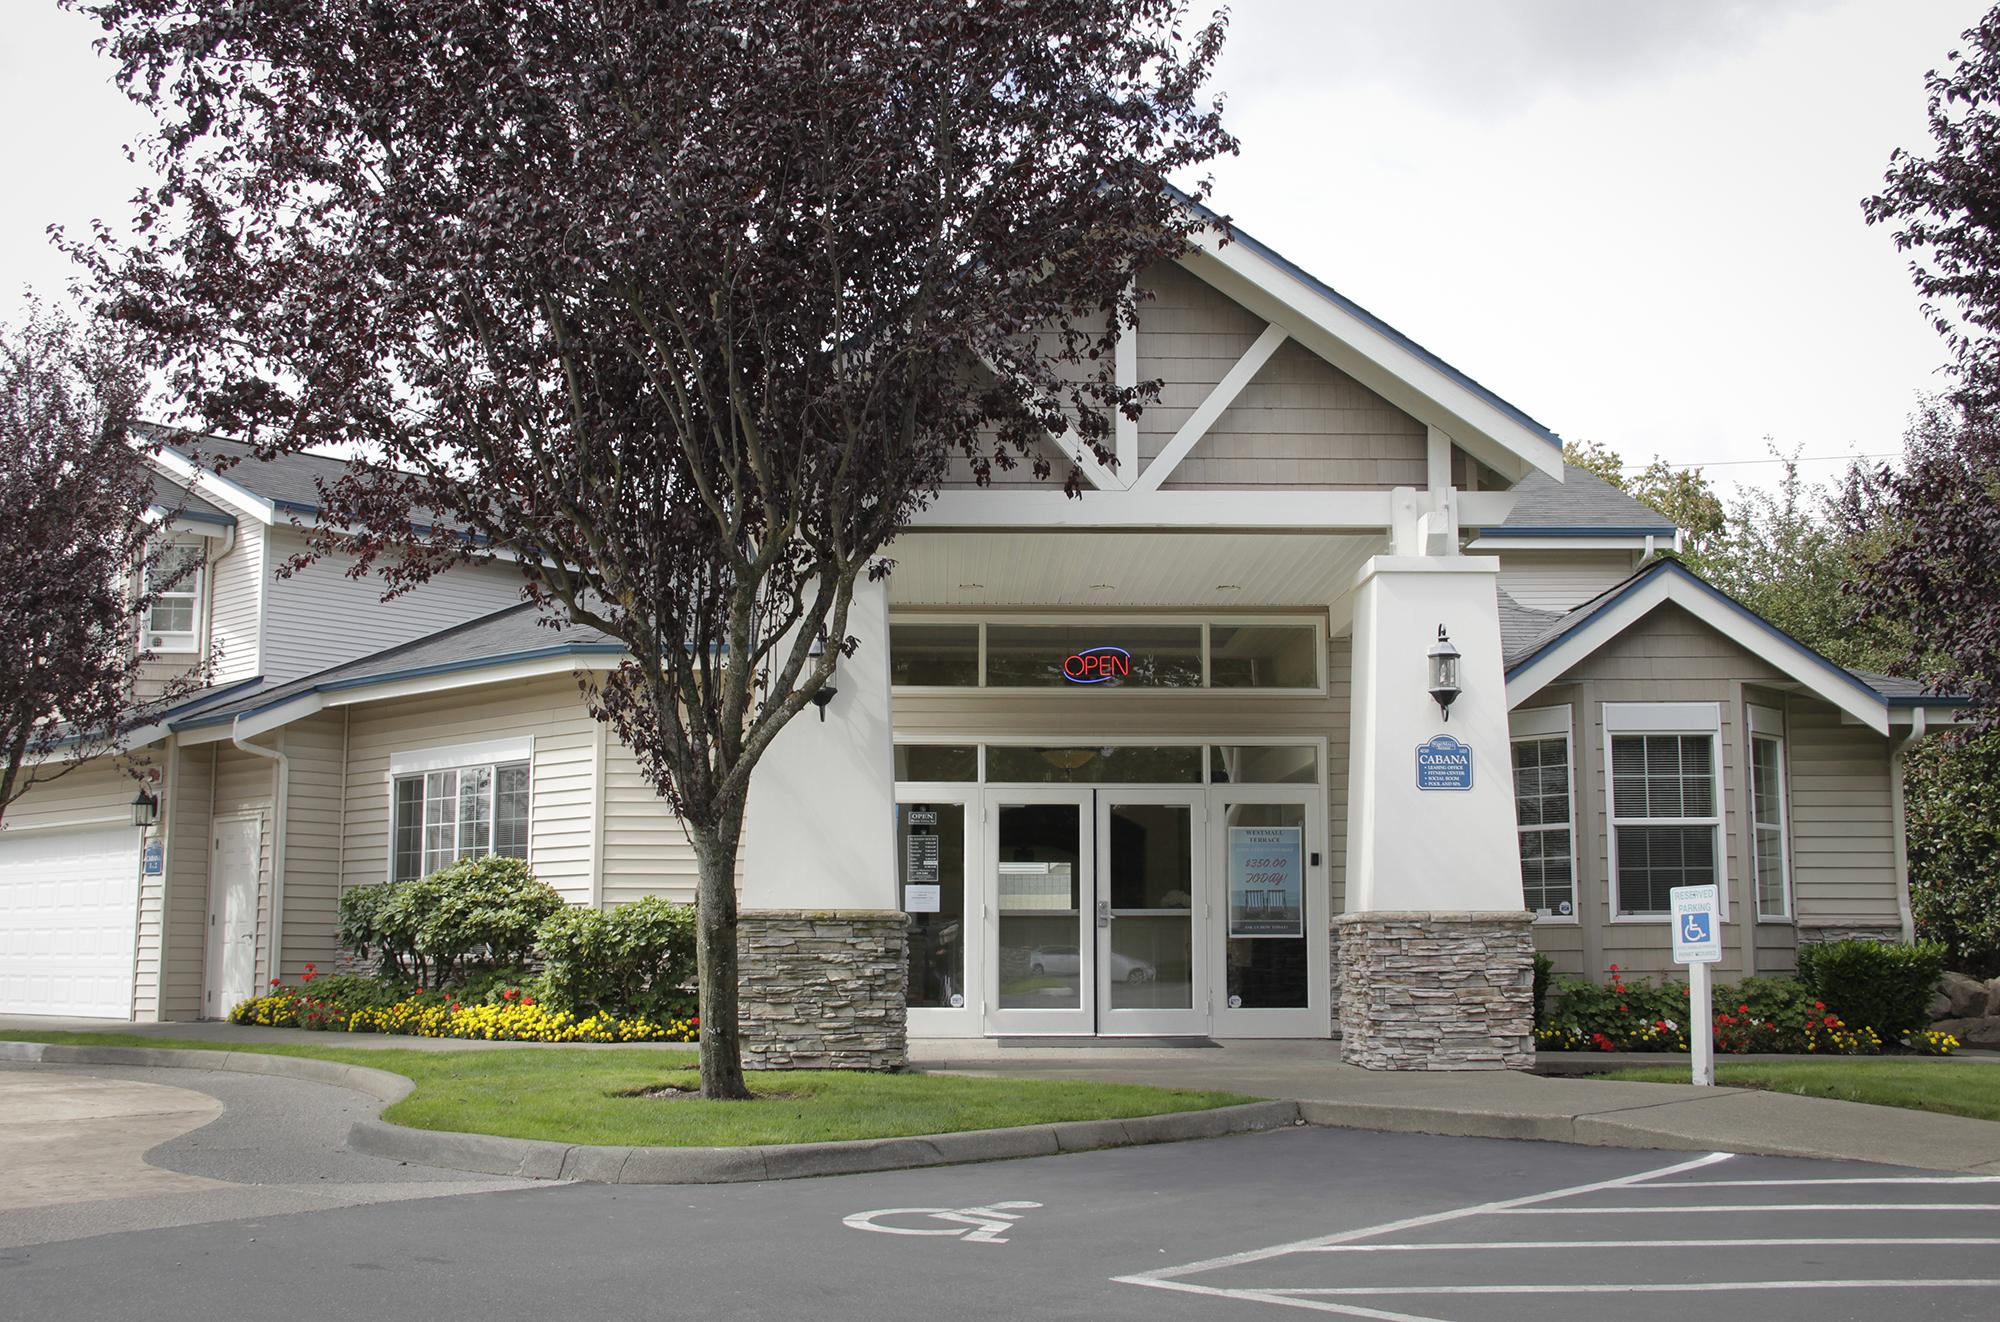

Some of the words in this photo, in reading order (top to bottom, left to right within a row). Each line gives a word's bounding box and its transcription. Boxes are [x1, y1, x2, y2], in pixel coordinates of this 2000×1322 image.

[1064, 655, 1129, 677] OPEN
[1419, 754, 1468, 764] CABANA
[1674, 889, 1713, 900] RESERVED
[1679, 902, 1712, 913] PARKING
